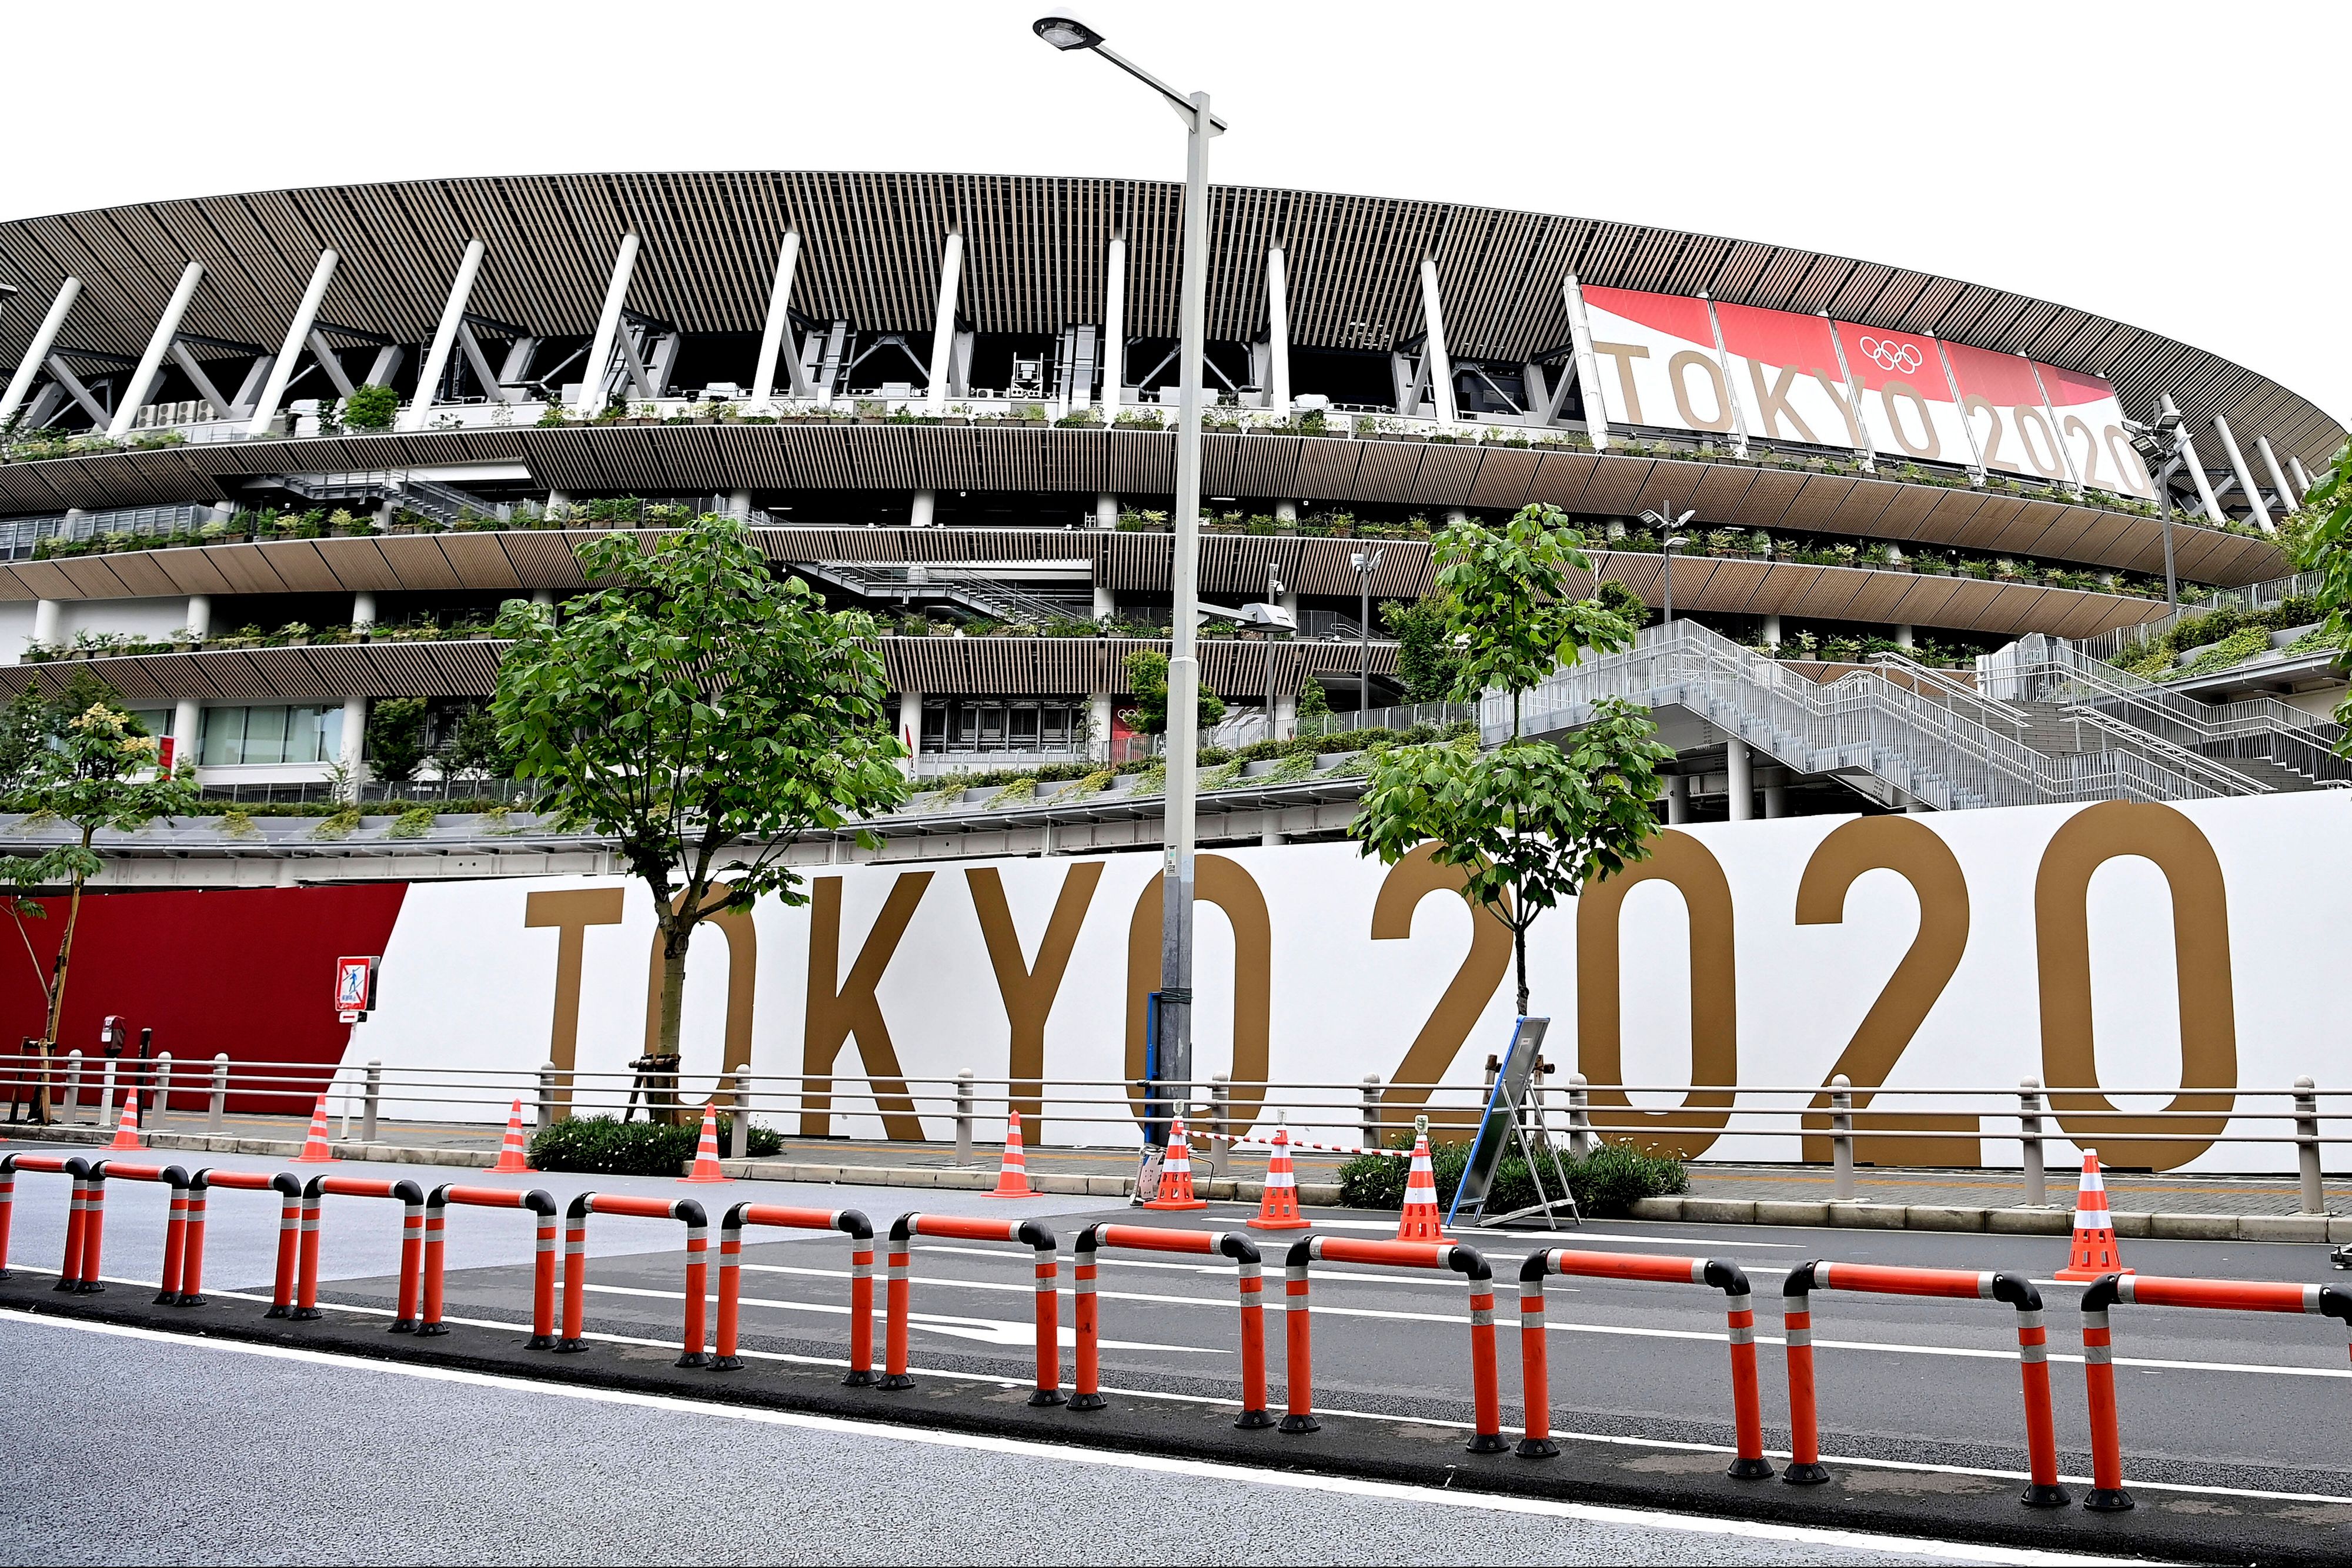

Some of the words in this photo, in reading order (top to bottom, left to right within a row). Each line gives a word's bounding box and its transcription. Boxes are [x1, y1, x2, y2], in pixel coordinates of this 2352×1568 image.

[1593, 341, 1940, 459] TOKYO
[1964, 394, 2153, 499] 2020
[524, 854, 1272, 1150] TOKYO
[1371, 800, 2237, 1172] 2020
